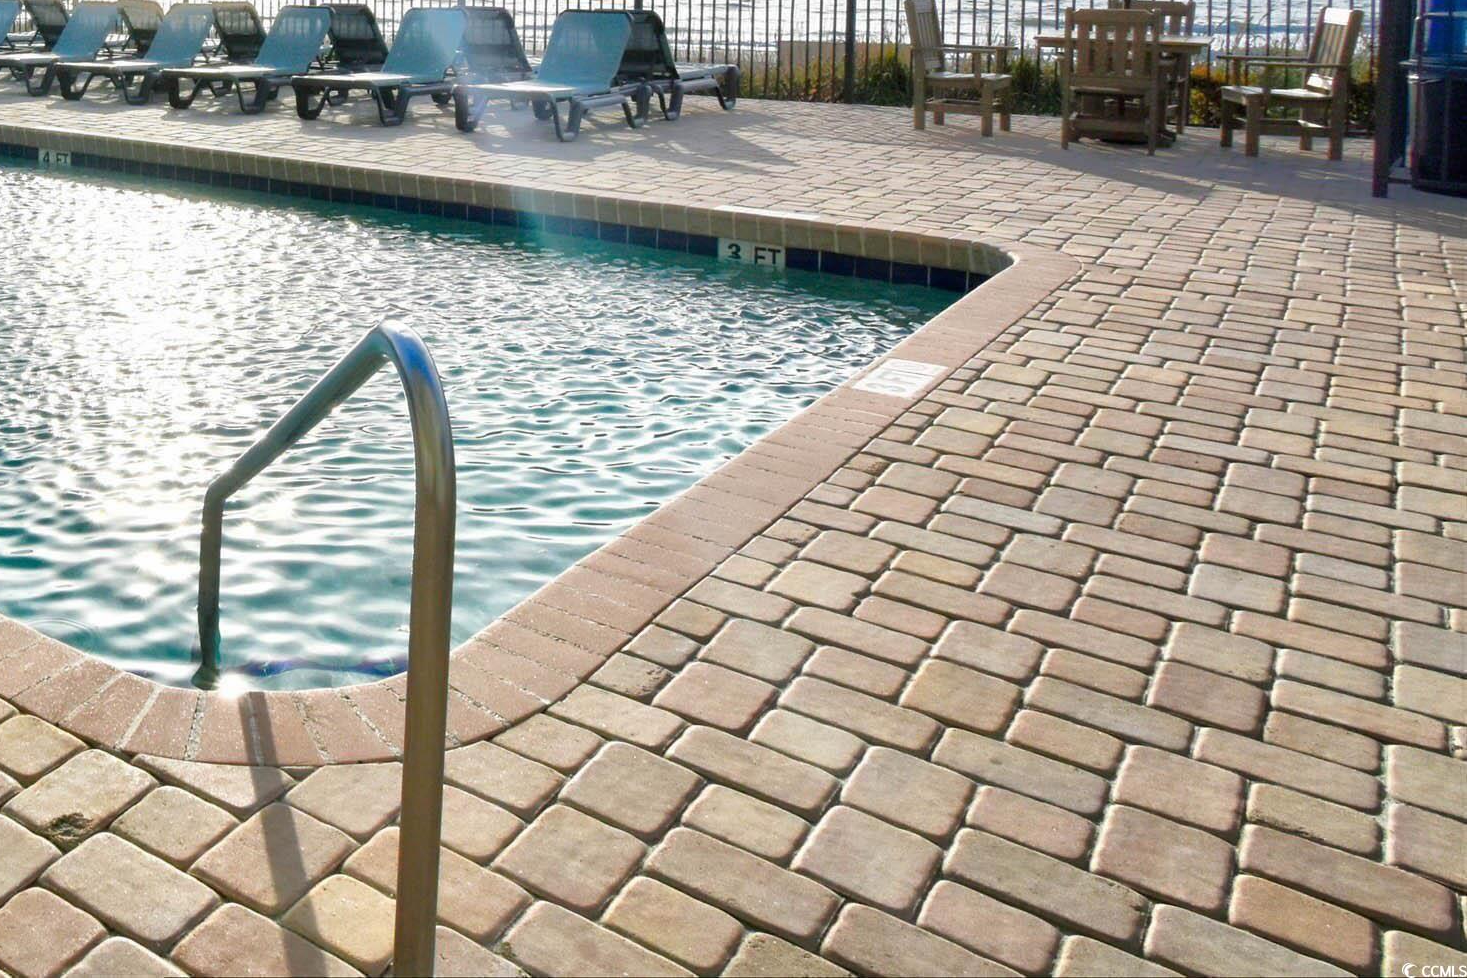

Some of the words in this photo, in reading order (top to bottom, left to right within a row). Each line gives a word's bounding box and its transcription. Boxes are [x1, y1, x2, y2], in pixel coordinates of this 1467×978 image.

[43, 150, 50, 162] 4
[56, 152, 69, 163] FT
[728, 243, 742, 259] 3
[754, 245, 781, 265] FT
